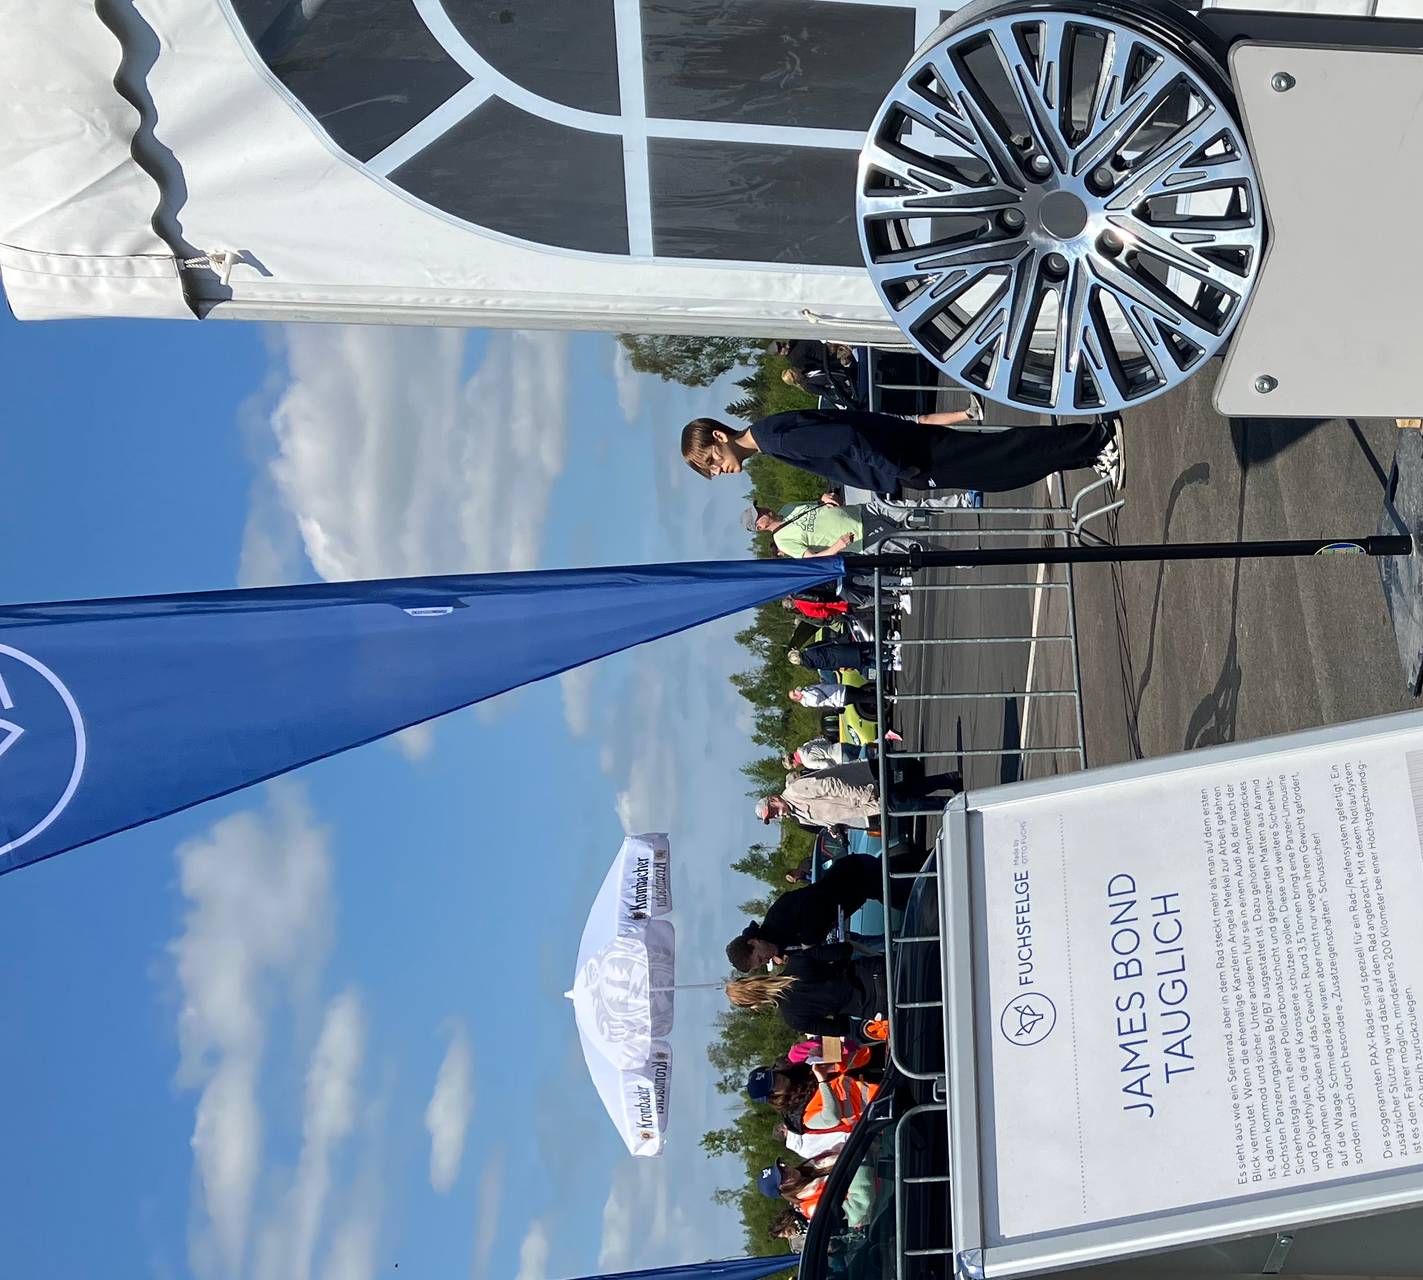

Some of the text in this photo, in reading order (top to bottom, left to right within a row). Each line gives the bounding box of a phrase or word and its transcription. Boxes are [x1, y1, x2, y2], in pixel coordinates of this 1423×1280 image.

[1331, 765, 1339, 779] Ein
[1201, 789, 1209, 816] ersten
[1226, 785, 1234, 798] der
[1253, 779, 1262, 810] Aramid
[1266, 778, 1278, 829] Sicherheits-
[1345, 763, 1358, 824] Notlaufsystem
[1214, 787, 1226, 825] gefahren
[1228, 800, 1236, 821] nach
[1279, 775, 1293, 850] Panzer-Limousine
[1358, 761, 1375, 849] Höchstgeschwindig-
[1240, 782, 1254, 855] zentimeterdickes
[1204, 840, 1213, 854] auf
[1217, 829, 1226, 855] Arbeit
[1259, 830, 1267, 863] Matten
[1273, 831, 1281, 864] weitere
[1297, 816, 1308, 853] Gewicht
[1354, 826, 1364, 858] diesem
[1020, 845, 1029, 864] OTTO
[1233, 857, 1242, 877] Audi
[1303, 855, 1311, 880] ihrem
[1358, 860, 1366, 875] Mit
[1371, 852, 1379, 874] einer
[629, 857, 649, 911] Krombacher
[1209, 878, 1217, 889] als
[1275, 866, 1284, 883] und
[1290, 873, 1300, 899] bringt
[1222, 875, 1231, 907] Merkel
[1238, 879, 1246, 907] einem
[1263, 865, 1277, 923] gepanzerten
[1279, 886, 1288, 912] Diese
[1306, 882, 1316, 912] wegen
[1210, 893, 1219, 916] mehr
[1241, 910, 1247, 918] in
[1253, 898, 1261, 921] Dazu
[1377, 893, 1388, 937] Kilometer
[1014, 870, 1034, 985] FUCHSFELGE
[1226, 910, 1237, 943] Angela
[1295, 901, 1304, 935] Tonnen
[1352, 914, 1360, 928] ein
[1213, 919, 1223, 947] steckt
[1242, 936, 1251, 954] fuhr
[1268, 926, 1278, 944] und
[1297, 937, 1306, 952] 3,5
[1311, 932, 1320, 955] nicht
[1367, 934, 1376, 952] Rad
[1216, 950, 1224, 968] Rad
[1382, 940, 1392, 960] 200
[1231, 946, 1241, 991] Kanzlerin
[1246, 956, 1256, 999] anderem
[1257, 939, 1270, 998] ausgestattet
[1287, 947, 1297, 990] schützen
[1299, 954, 1309, 979] Rund
[1315, 958, 1324, 978] aber
[1355, 947, 1369, 982] speziell
[1372, 954, 1380, 975] dem
[1150, 892, 1195, 1084] TAUGLICH
[1219, 971, 1227, 993] dem
[1373, 978, 1383, 992] auf
[1387, 962, 1401, 1018] mindestens
[1107, 873, 1155, 1119] JAMES BOND
[1222, 995, 1228, 1004] in
[1319, 981, 1327, 1010] waren
[1360, 985, 1371, 1006] sind
[1378, 995, 1387, 1022] dabei
[1223, 1007, 1231, 1028] aber
[1235, 994, 1247, 1046] ehemalige
[1250, 1002, 1259, 1029] Unter
[1262, 1002, 1274, 1032] B6/B7
[1292, 993, 1303, 1044] Karosserie
[1309, 1025, 1318, 1042] das
[1336, 1005, 1348, 1058] besondere
[1381, 1024, 1390, 1045] wird
[1240, 1049, 1249, 1065] die
[1284, 1048, 1293, 1072] einer
[1297, 1048, 1306, 1063] die
[1310, 1045, 1320, 1059] auf
[1243, 1068, 1252, 1099] Wenn
[1256, 1065, 1265, 1084] und
[1268, 1035, 1284, 1125] Panzerungsklasse
[1286, 1075, 1295, 1092] mit
[1300, 1066, 1308, 1081] die
[1341, 1061, 1353, 1090] durch
[1386, 1048, 1398, 1093] Stützring
[1402, 1066, 1413, 1099] Fahrer
[1258, 1087, 1270, 1133] kommod
[1346, 1093, 1356, 1117] auch
[1374, 1069, 1390, 1137] sogenannten
[1408, 1102, 1417, 1125] dem
[1288, 1095, 1305, 1174] Sicherheitsglas
[1320, 1105, 1333, 1169] maßnahmen
[1337, 1132, 1346, 1147] die
[1351, 1121, 1363, 1164] sondern
[1412, 1127, 1419, 1139] es
[1236, 1144, 1246, 1169] sieht
[1265, 1136, 1274, 1162] dann
[1338, 1151, 1348, 1166] auf
[1383, 1140, 1392, 1158] Die
[1412, 1142, 1421, 1153] ist
[1251, 1156, 1261, 1182] Blick
[1309, 1151, 1319, 1171] und
[1238, 1171, 1247, 1184] Es
